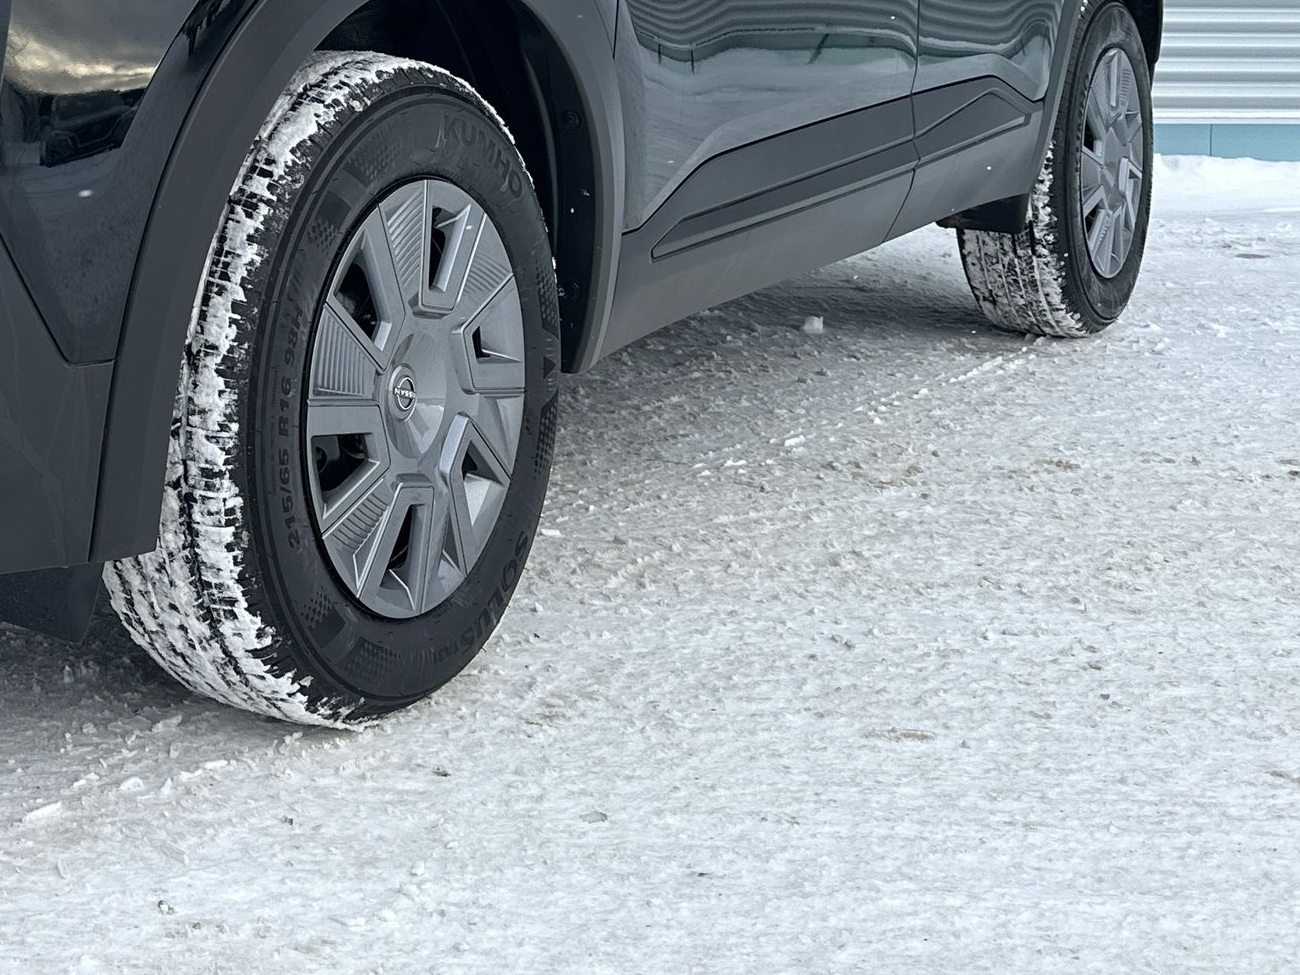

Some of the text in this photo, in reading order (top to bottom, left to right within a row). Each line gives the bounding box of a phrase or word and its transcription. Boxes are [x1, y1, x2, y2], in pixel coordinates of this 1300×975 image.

[278, 375, 293, 437] R16
[277, 448, 300, 548] 215/65
[460, 530, 528, 653] SOLUS
